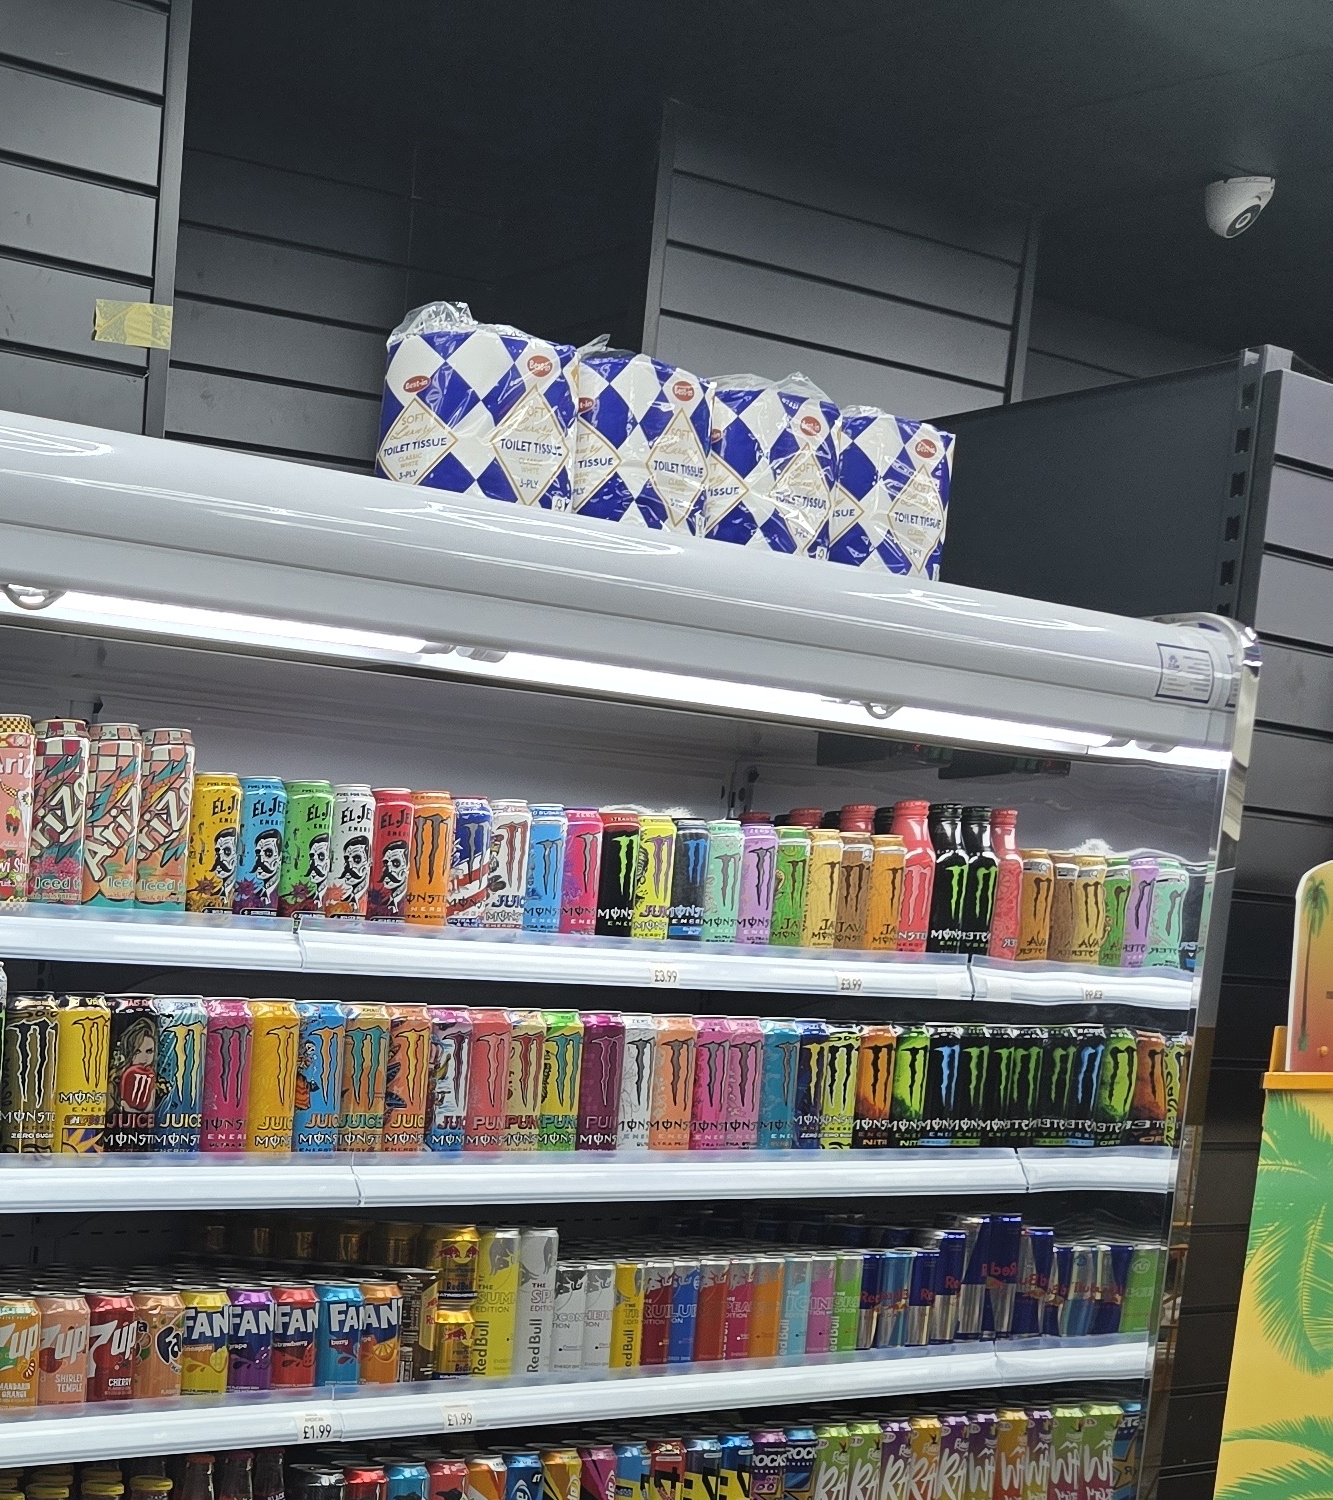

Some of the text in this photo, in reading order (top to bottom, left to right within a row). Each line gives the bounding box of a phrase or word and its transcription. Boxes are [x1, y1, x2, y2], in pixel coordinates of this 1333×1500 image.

[404, 379, 429, 391] Best-in
[383, 437, 447, 457] TOILET TISSUE
[399, 470, 417, 480] 3-PLY
[654, 970, 678, 984] £3.99
[840, 979, 862, 990] £3.99
[526, 1318, 542, 1373] Red Bull
[56, 1375, 83, 1383] SHIRLEY
[57, 1383, 82, 1392] TEMPLE
[448, 1412, 472, 1427] £1.99
[303, 1423, 332, 1439] £1.99
